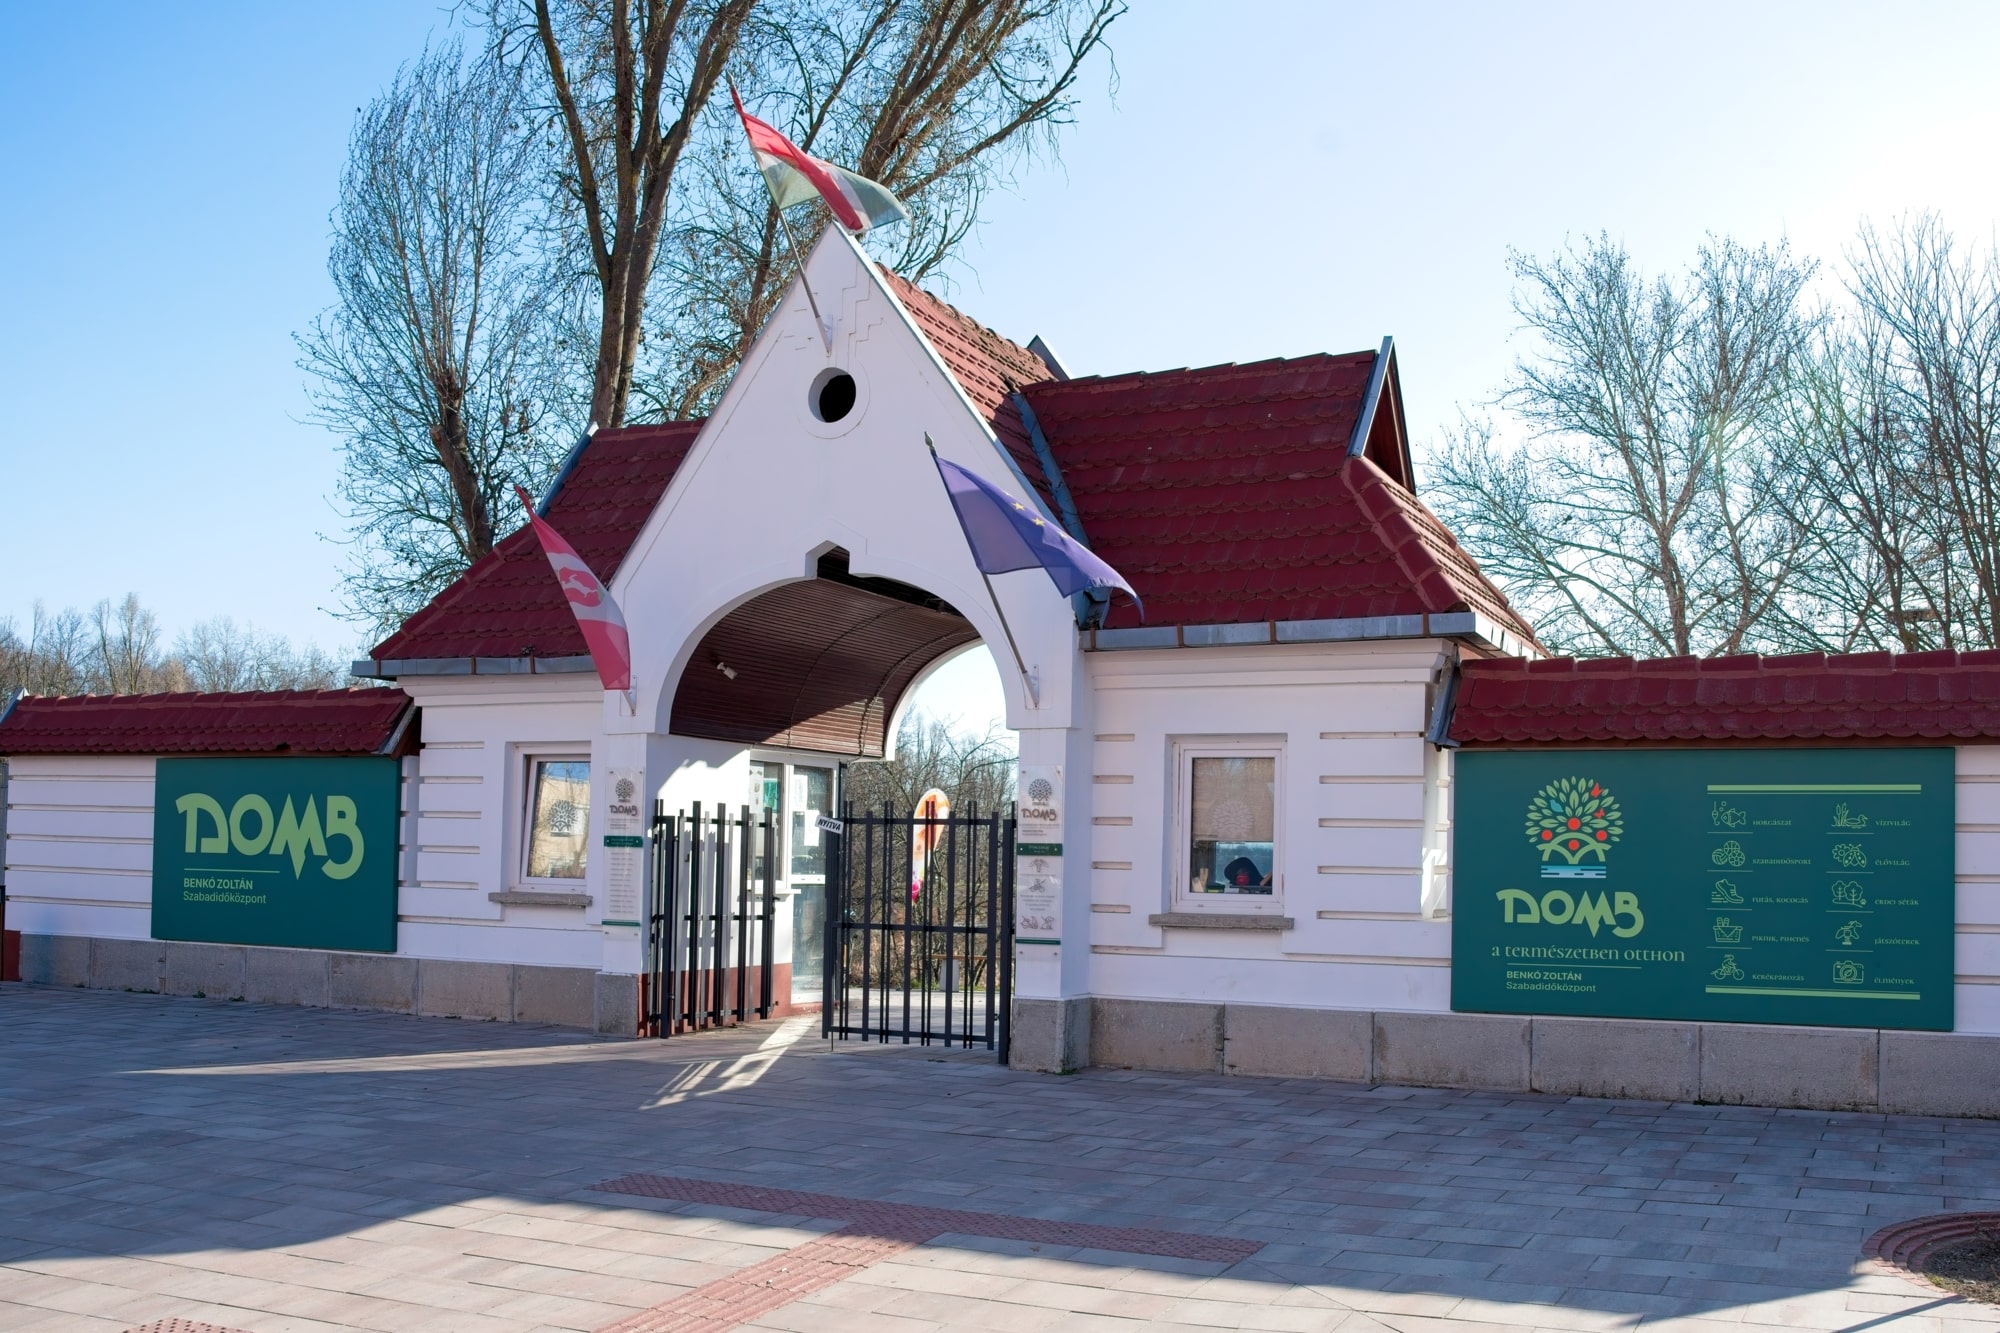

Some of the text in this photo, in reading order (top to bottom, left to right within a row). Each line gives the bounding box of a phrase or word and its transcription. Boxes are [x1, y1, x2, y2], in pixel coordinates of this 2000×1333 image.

[609, 805, 638, 817] DOMB
[1021, 808, 1057, 822] DOMB
[175, 792, 365, 881] DOMB
[184, 876, 253, 890] BENKÓ ZOLTÁN
[183, 890, 267, 906] Szabadidőközpont
[1495, 888, 1645, 939] DOMB
[1491, 946, 1500, 957] a
[1506, 969, 1582, 981] BENKÓ ZOLTÁN
[1506, 981, 1597, 993] Szabadidőközpont
